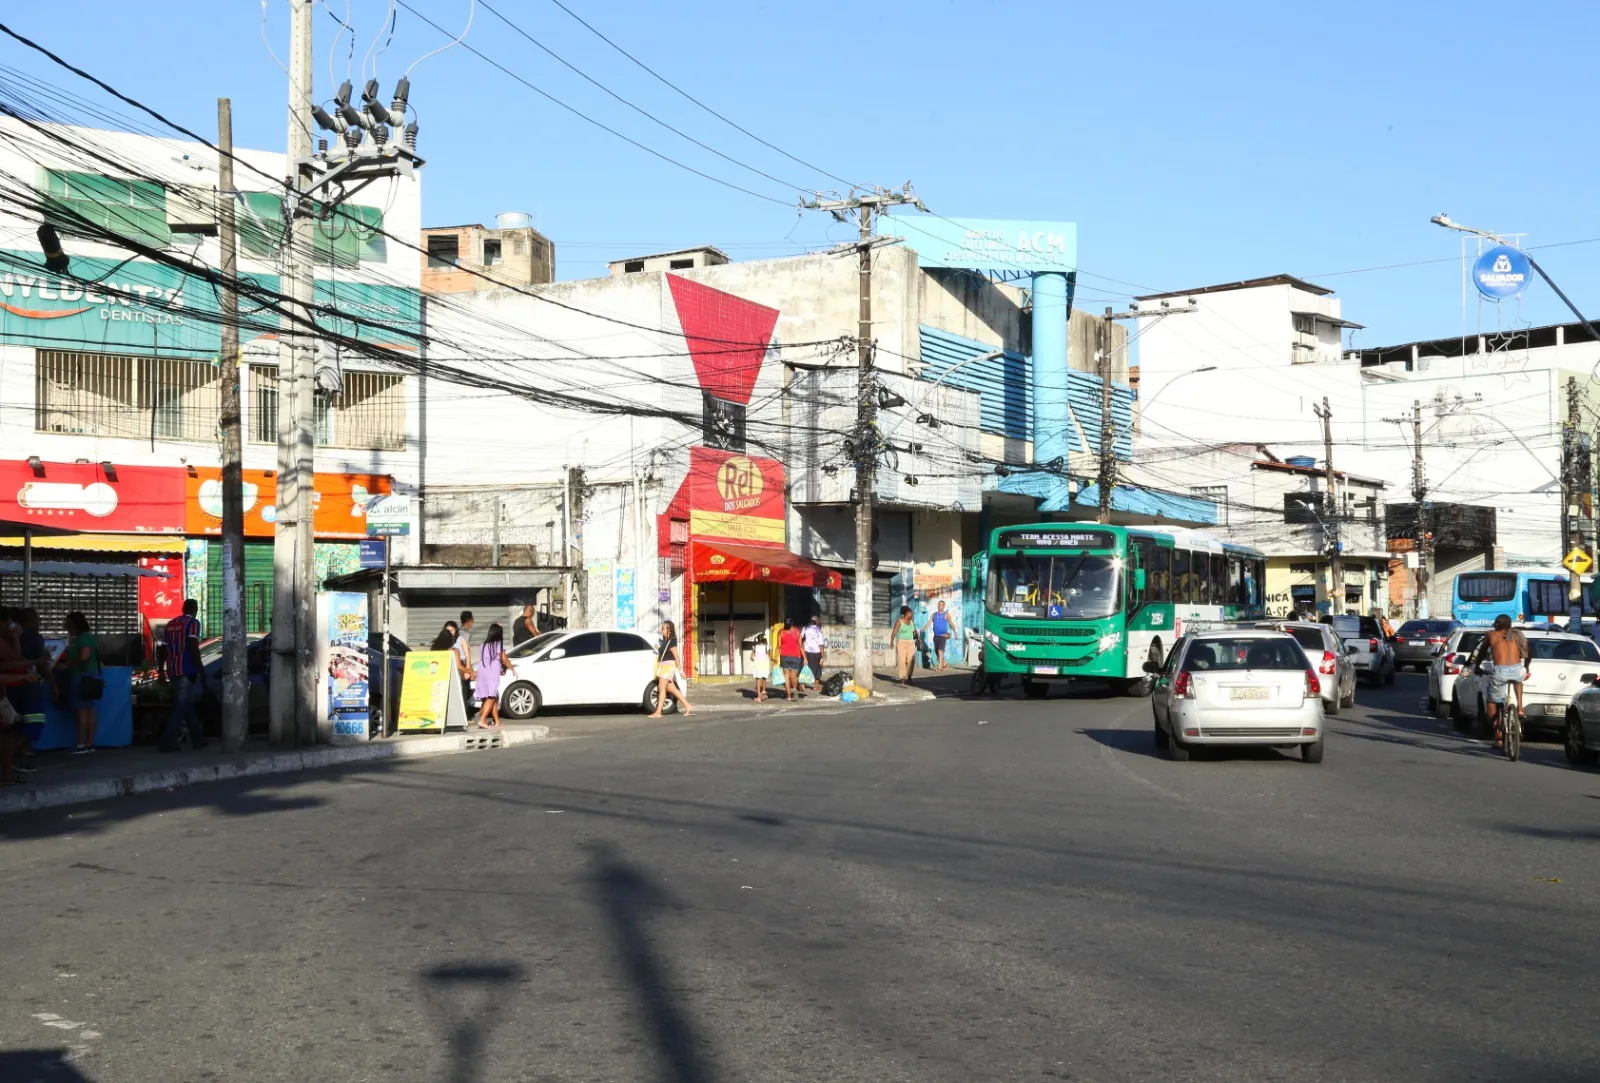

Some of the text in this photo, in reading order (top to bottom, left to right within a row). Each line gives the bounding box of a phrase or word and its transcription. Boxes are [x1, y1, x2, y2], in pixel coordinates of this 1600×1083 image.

[1015, 228, 1065, 254] ACM
[1480, 273, 1524, 282] SALVADOR
[100, 308, 184, 326] DENTISTAS
[724, 498, 760, 512] DOS SALGADOS
[1265, 593, 1289, 602] NICA
[335, 721, 364, 734] 10666
